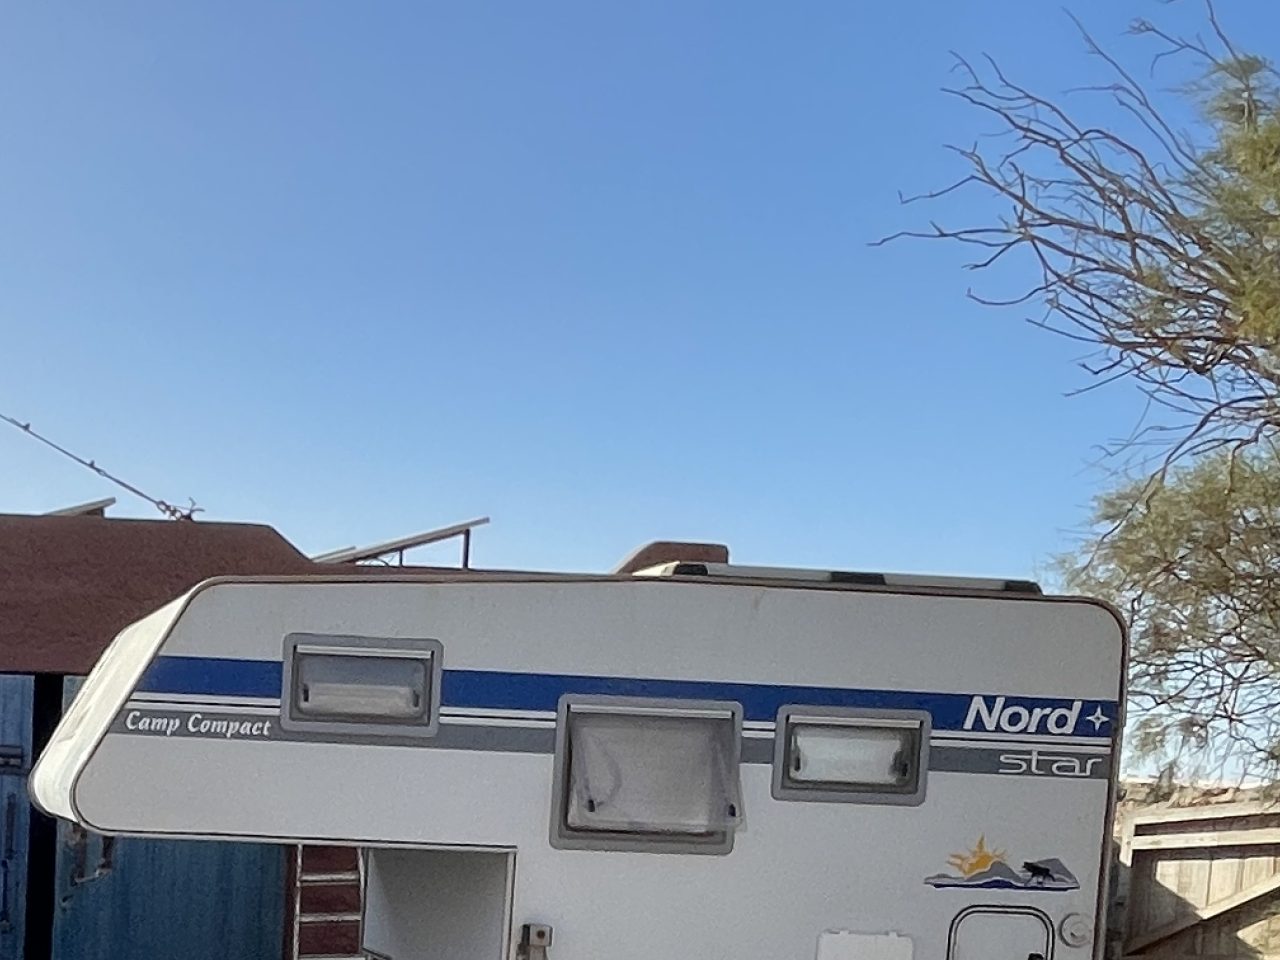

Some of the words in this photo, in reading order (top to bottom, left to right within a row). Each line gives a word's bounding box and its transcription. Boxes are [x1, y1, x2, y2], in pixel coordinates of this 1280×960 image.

[126, 711, 180, 735] Camp
[187, 714, 271, 738] Compact
[963, 696, 1082, 734] Nord
[999, 750, 1102, 776] star
